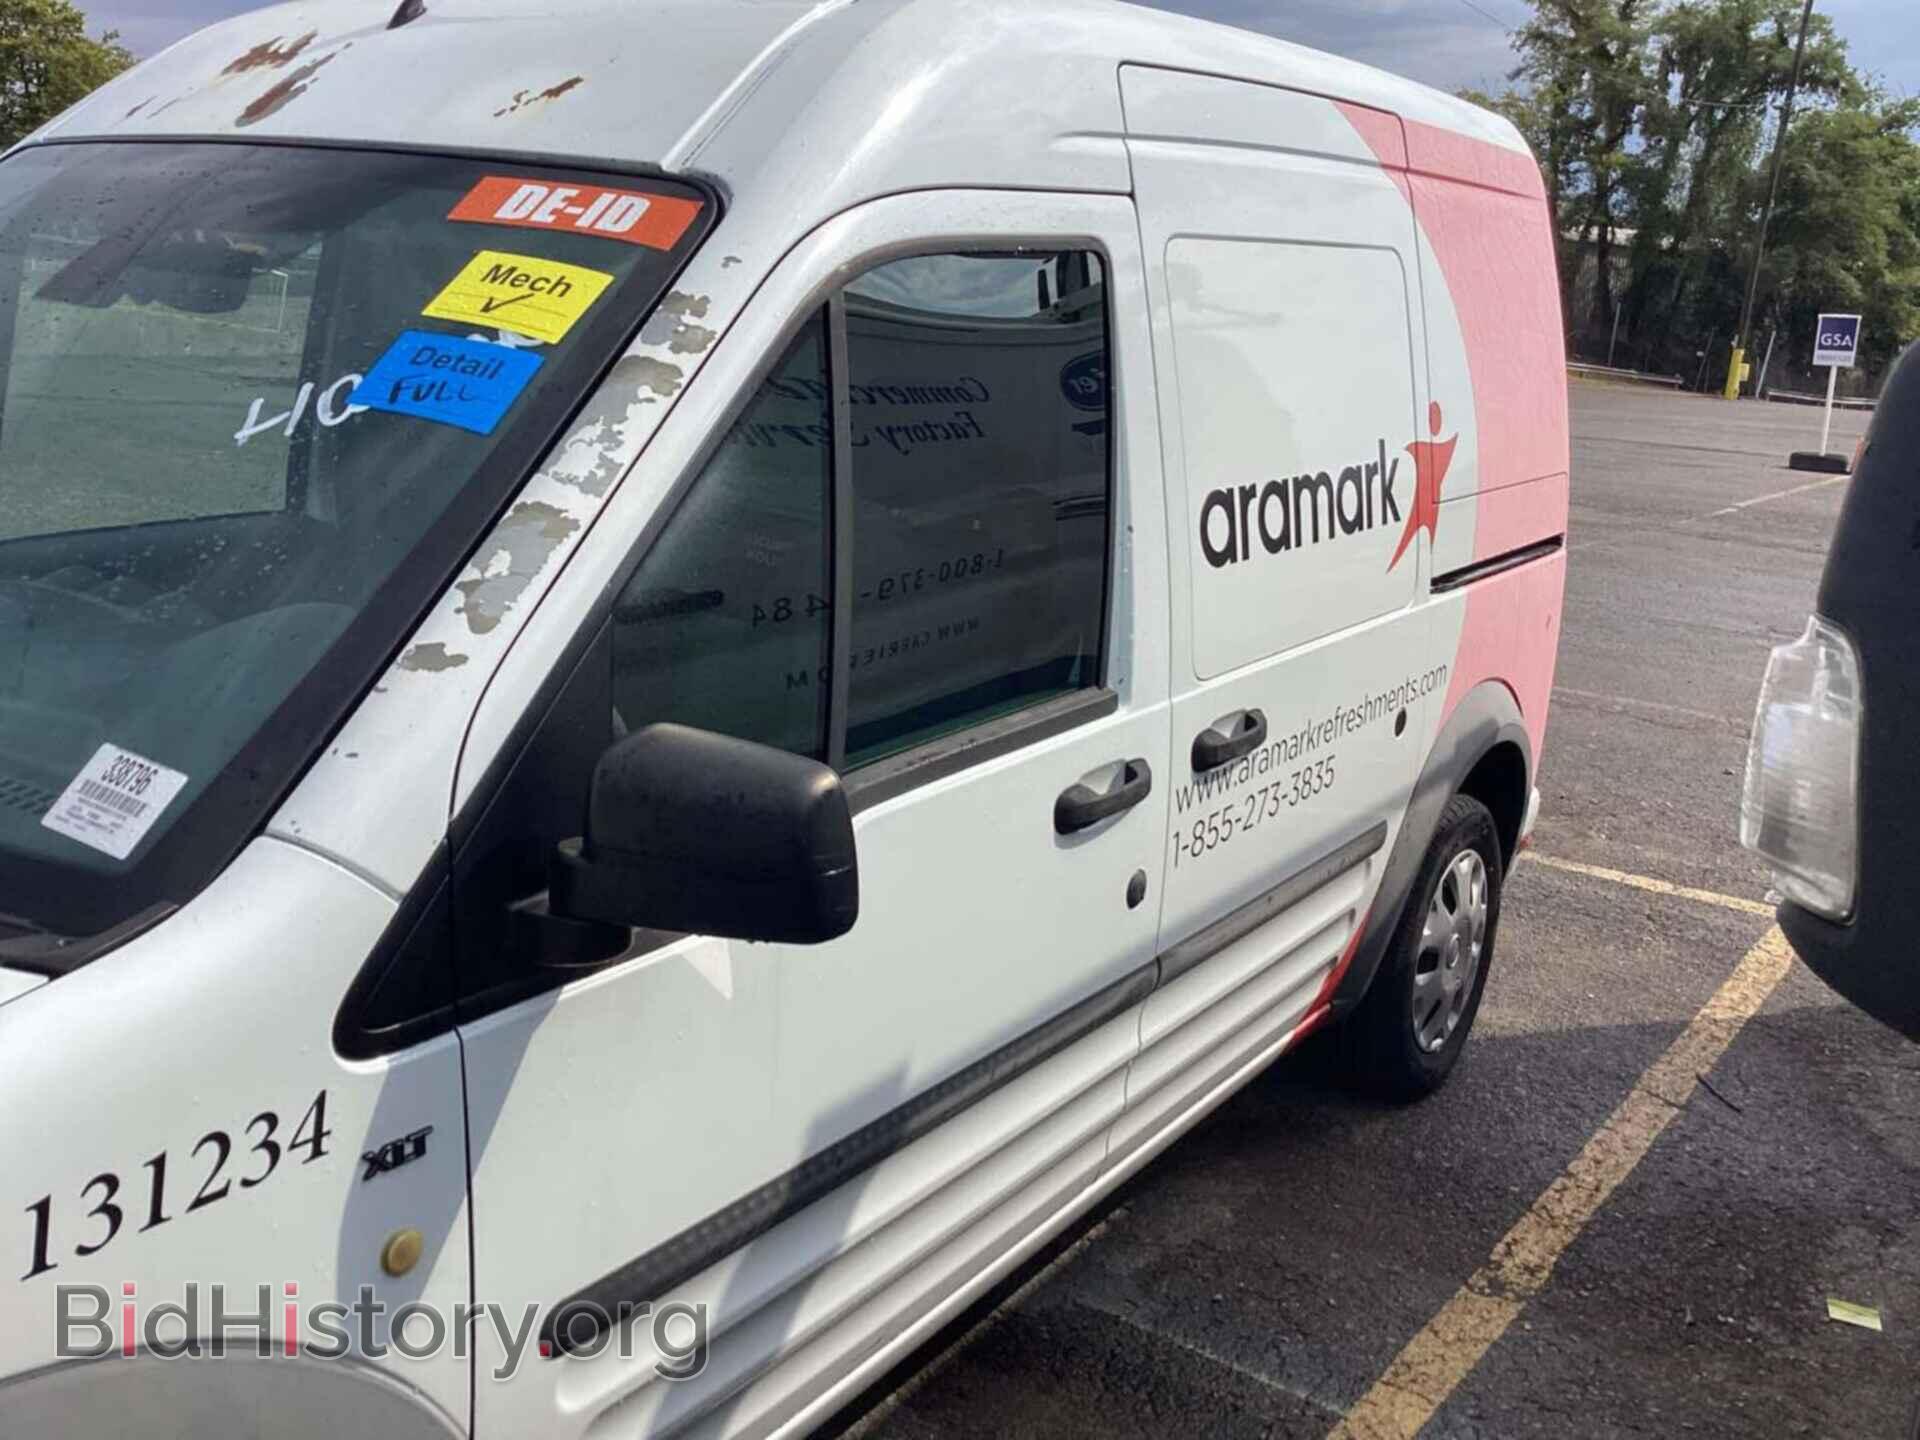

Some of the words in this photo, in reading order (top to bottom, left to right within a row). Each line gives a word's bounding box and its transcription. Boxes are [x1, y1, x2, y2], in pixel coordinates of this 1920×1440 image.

[494, 184, 651, 233] DE-ID
[480, 263, 575, 298] Mech
[409, 345, 502, 380] Detail
[1820, 332, 1852, 347] GSA
[388, 373, 476, 405] FULL
[1199, 438, 1401, 568] aramark
[1175, 664, 1448, 815] www.aramarkrefreshments.com
[1171, 754, 1337, 869] 1-855-273-3835
[361, 1125, 434, 1182] XLT
[19, 1088, 332, 1282] 131234
